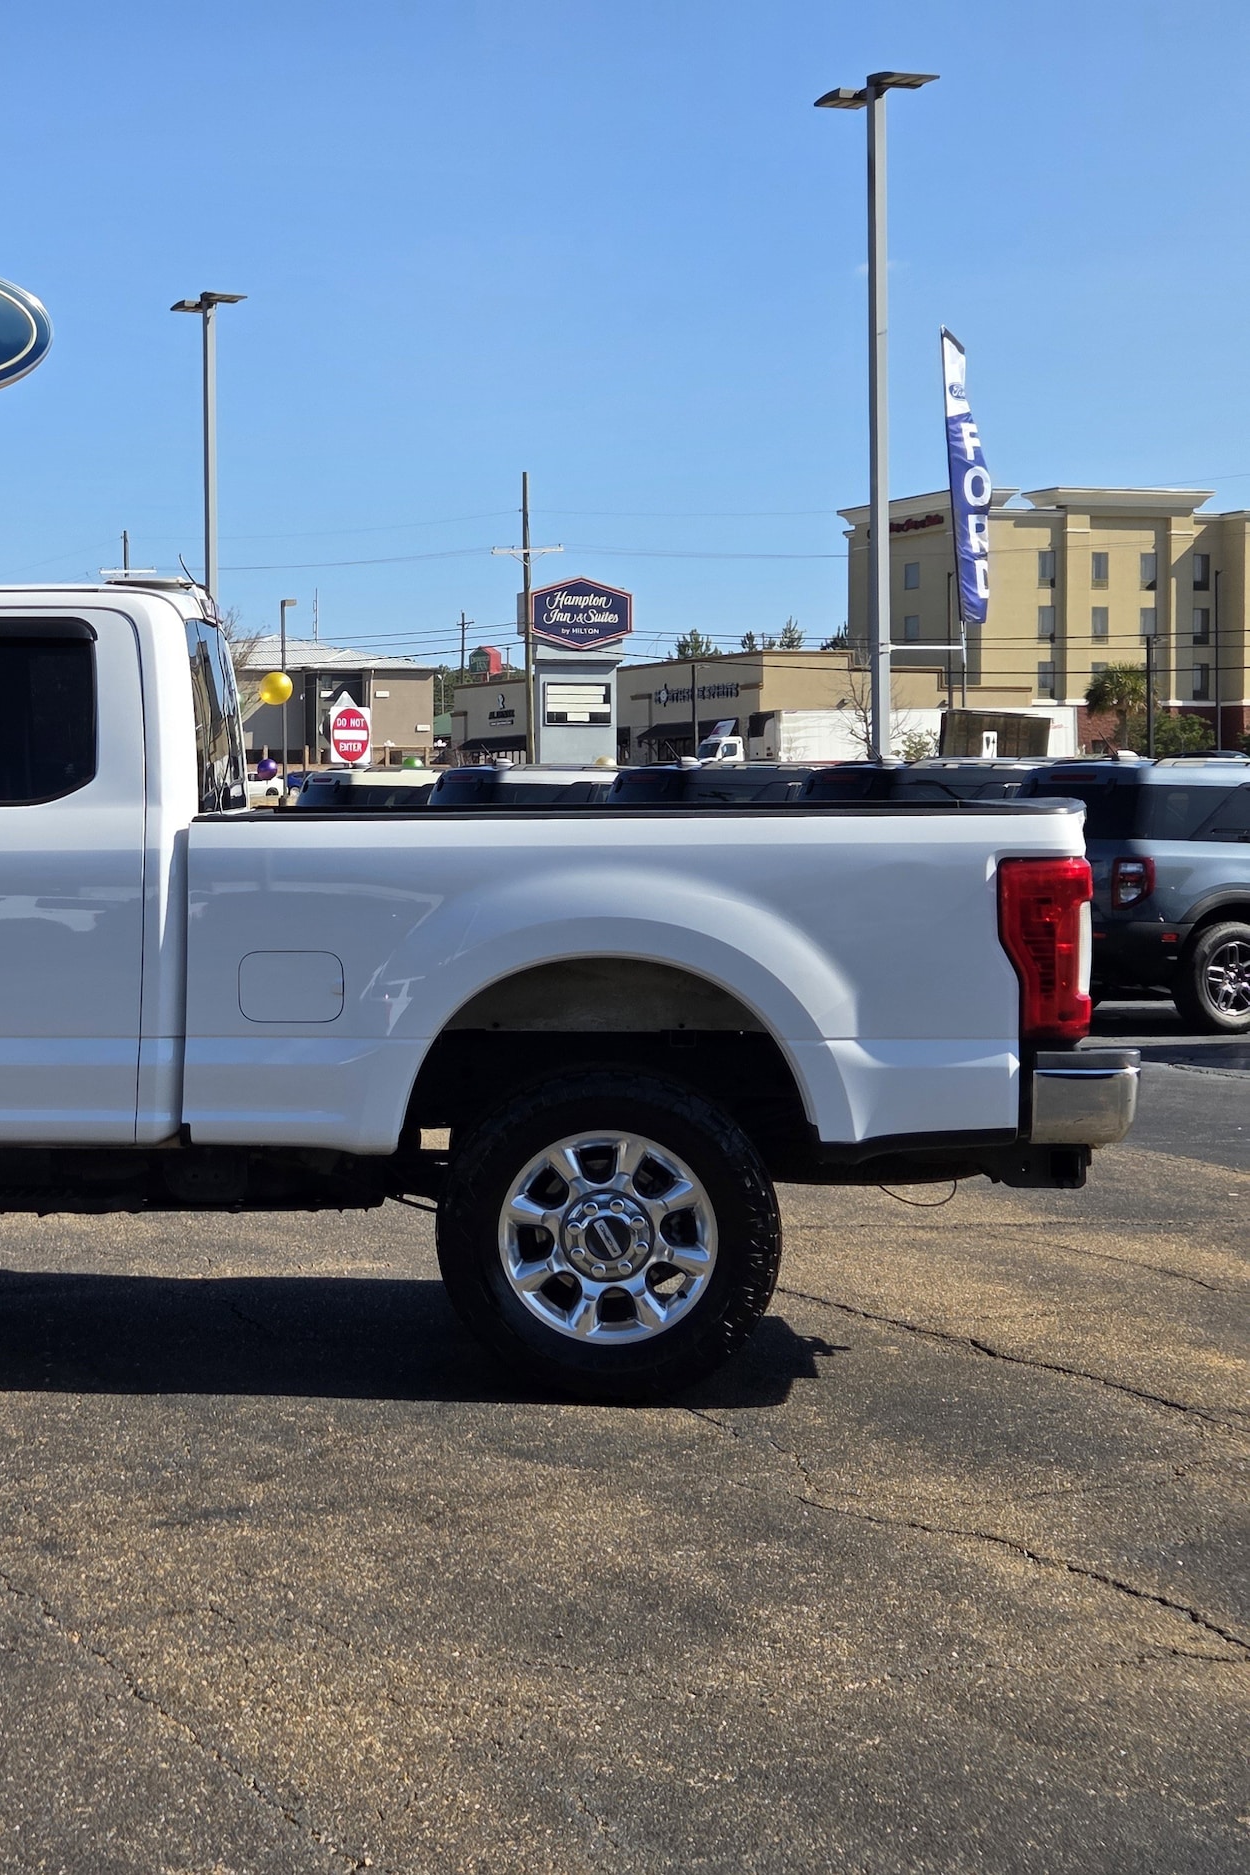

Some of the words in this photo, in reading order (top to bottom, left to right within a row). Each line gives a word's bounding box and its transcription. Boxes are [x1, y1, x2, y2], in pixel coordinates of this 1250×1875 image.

[960, 422, 992, 600] FORD
[546, 591, 612, 609] Hampton
[543, 609, 577, 624] Inn
[576, 614, 585, 624] &
[584, 609, 619, 624] Suites
[336, 717, 347, 727] DO
[350, 718, 365, 727] NOT
[340, 742, 363, 752] ENTER
